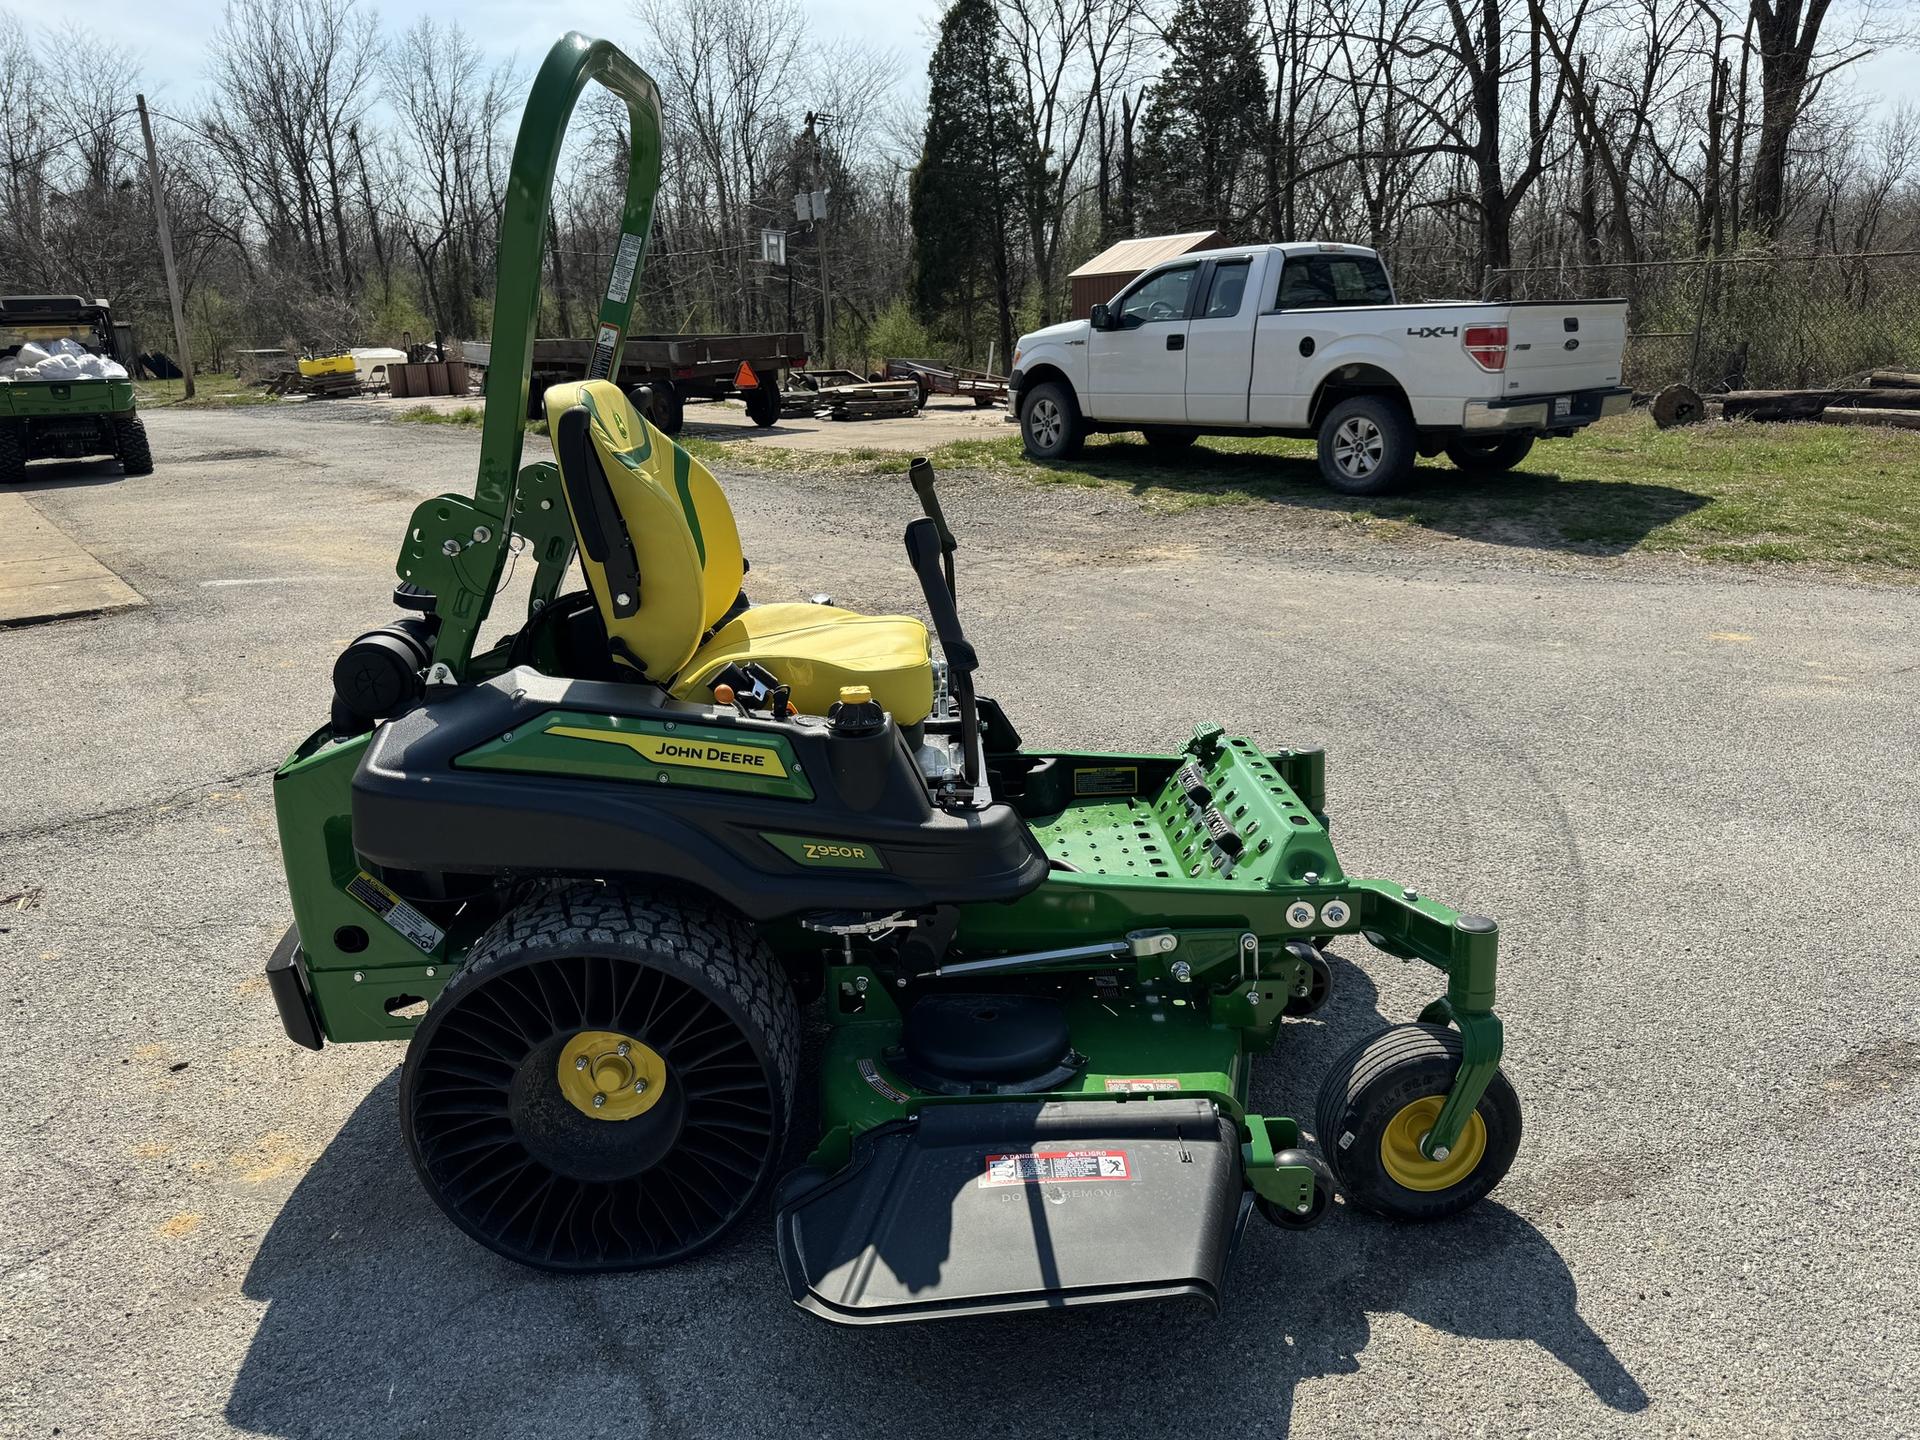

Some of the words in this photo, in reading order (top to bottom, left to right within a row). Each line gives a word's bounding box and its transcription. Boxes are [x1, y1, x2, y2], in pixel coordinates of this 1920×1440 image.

[1407, 326, 1459, 338] 4X4
[655, 742, 703, 760] JOHN
[706, 747, 765, 767] DEERE
[802, 844, 866, 859] Z950R
[1075, 1150, 1107, 1158] PELIGRO
[1001, 1192, 1022, 1203] DO
